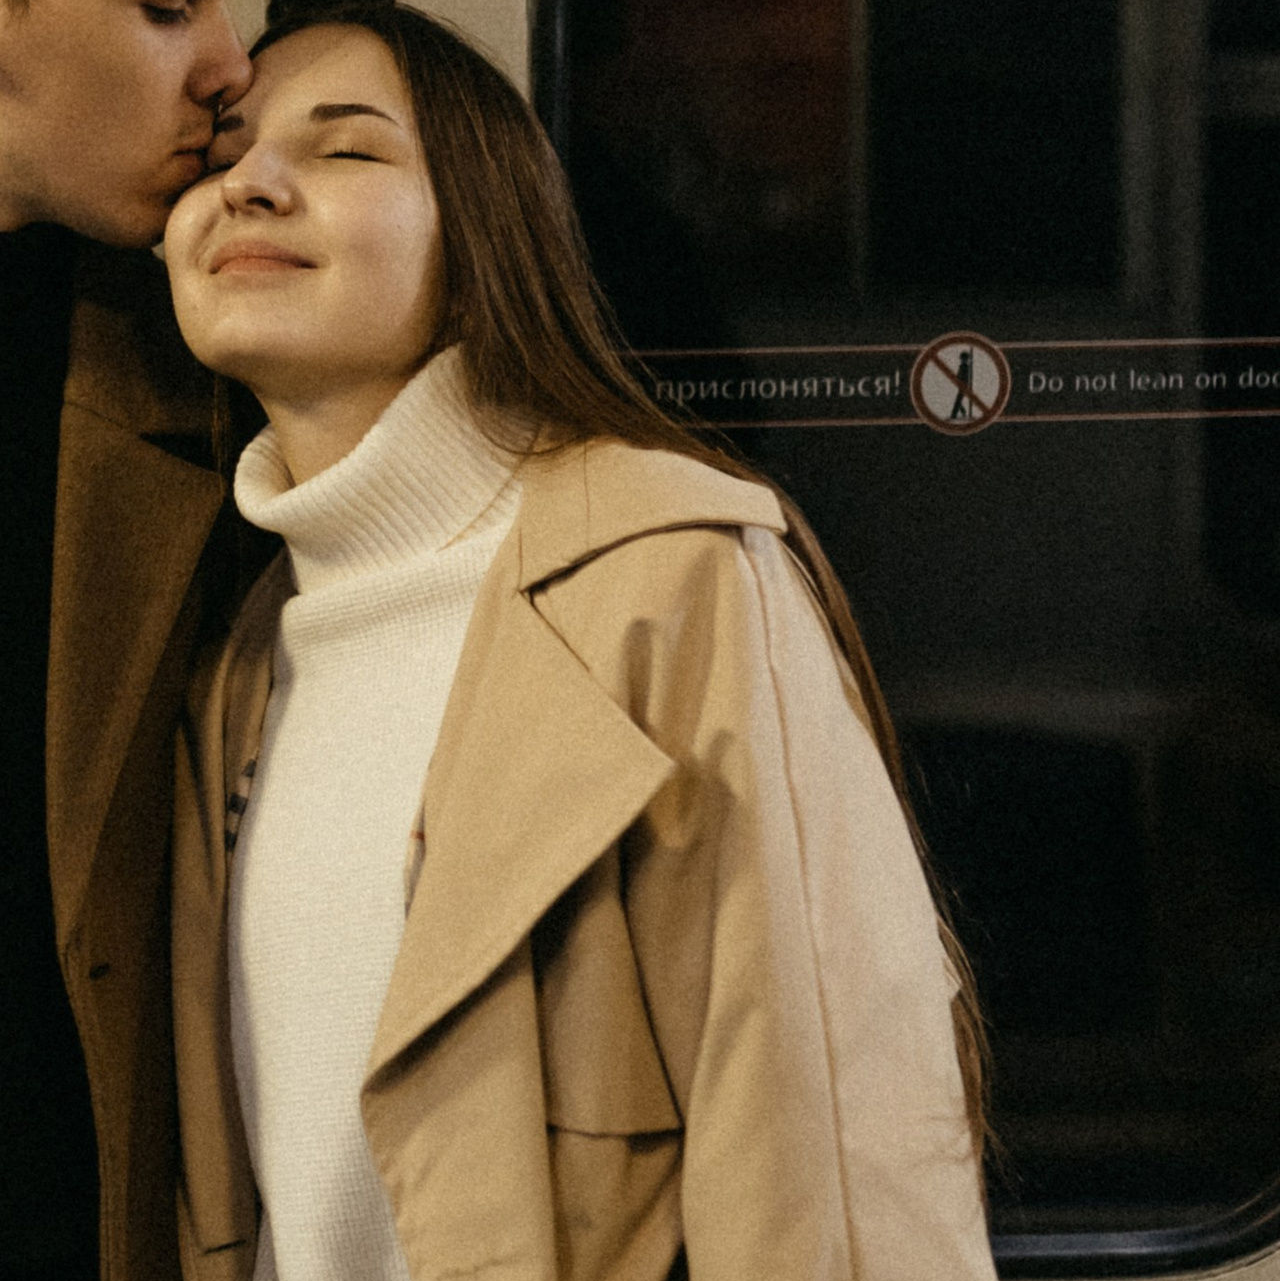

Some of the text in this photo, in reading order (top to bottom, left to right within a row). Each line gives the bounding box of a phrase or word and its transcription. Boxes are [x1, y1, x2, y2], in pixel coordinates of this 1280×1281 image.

[655, 369, 901, 406] прислоняться!
[1028, 370, 1064, 394] Do
[1075, 371, 1117, 392] not
[1129, 368, 1184, 391] lean
[1195, 371, 1227, 390] on
